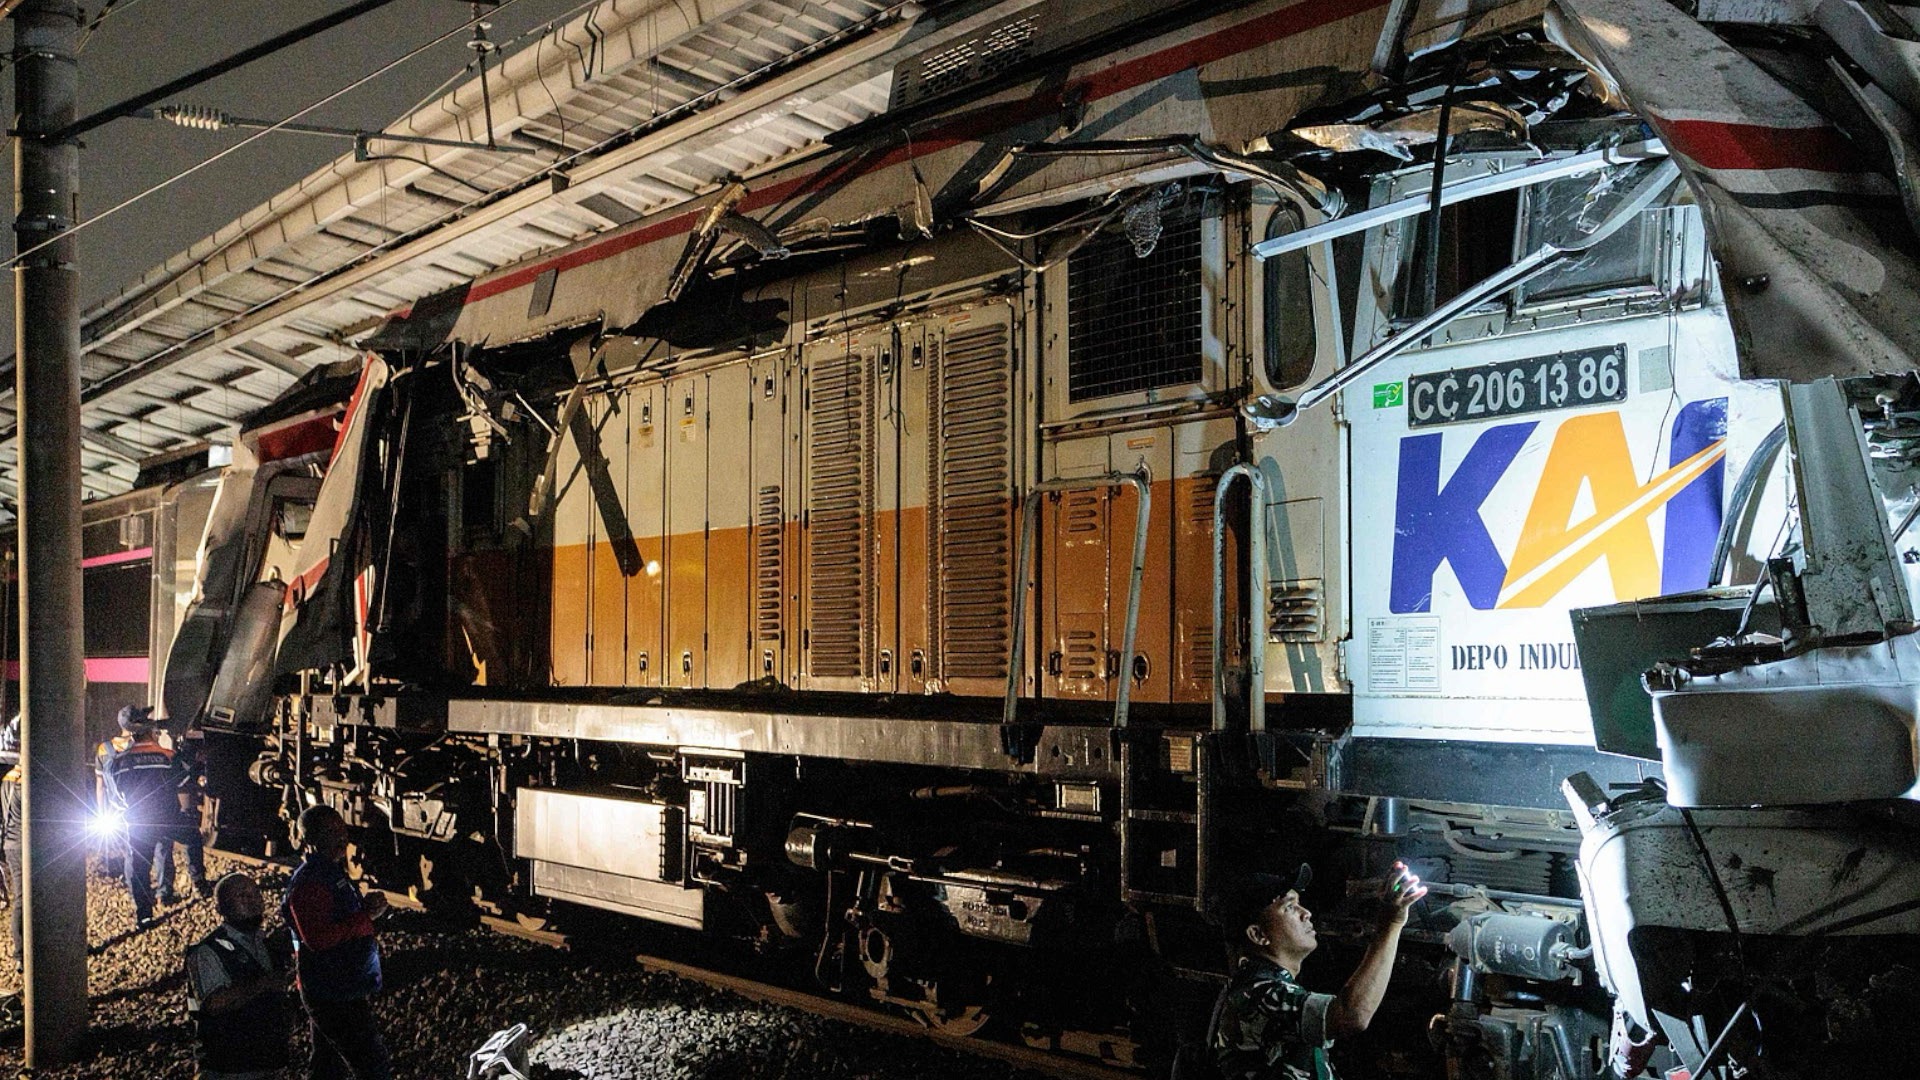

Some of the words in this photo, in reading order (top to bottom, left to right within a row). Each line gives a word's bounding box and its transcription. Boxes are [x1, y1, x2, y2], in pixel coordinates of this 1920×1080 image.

[1412, 378, 1459, 420] CC
[1467, 368, 1525, 414] 206
[1534, 362, 1569, 405] 13
[1578, 354, 1620, 399] 86
[1389, 396, 1729, 614] KAI
[1451, 644, 1508, 670] DEPO
